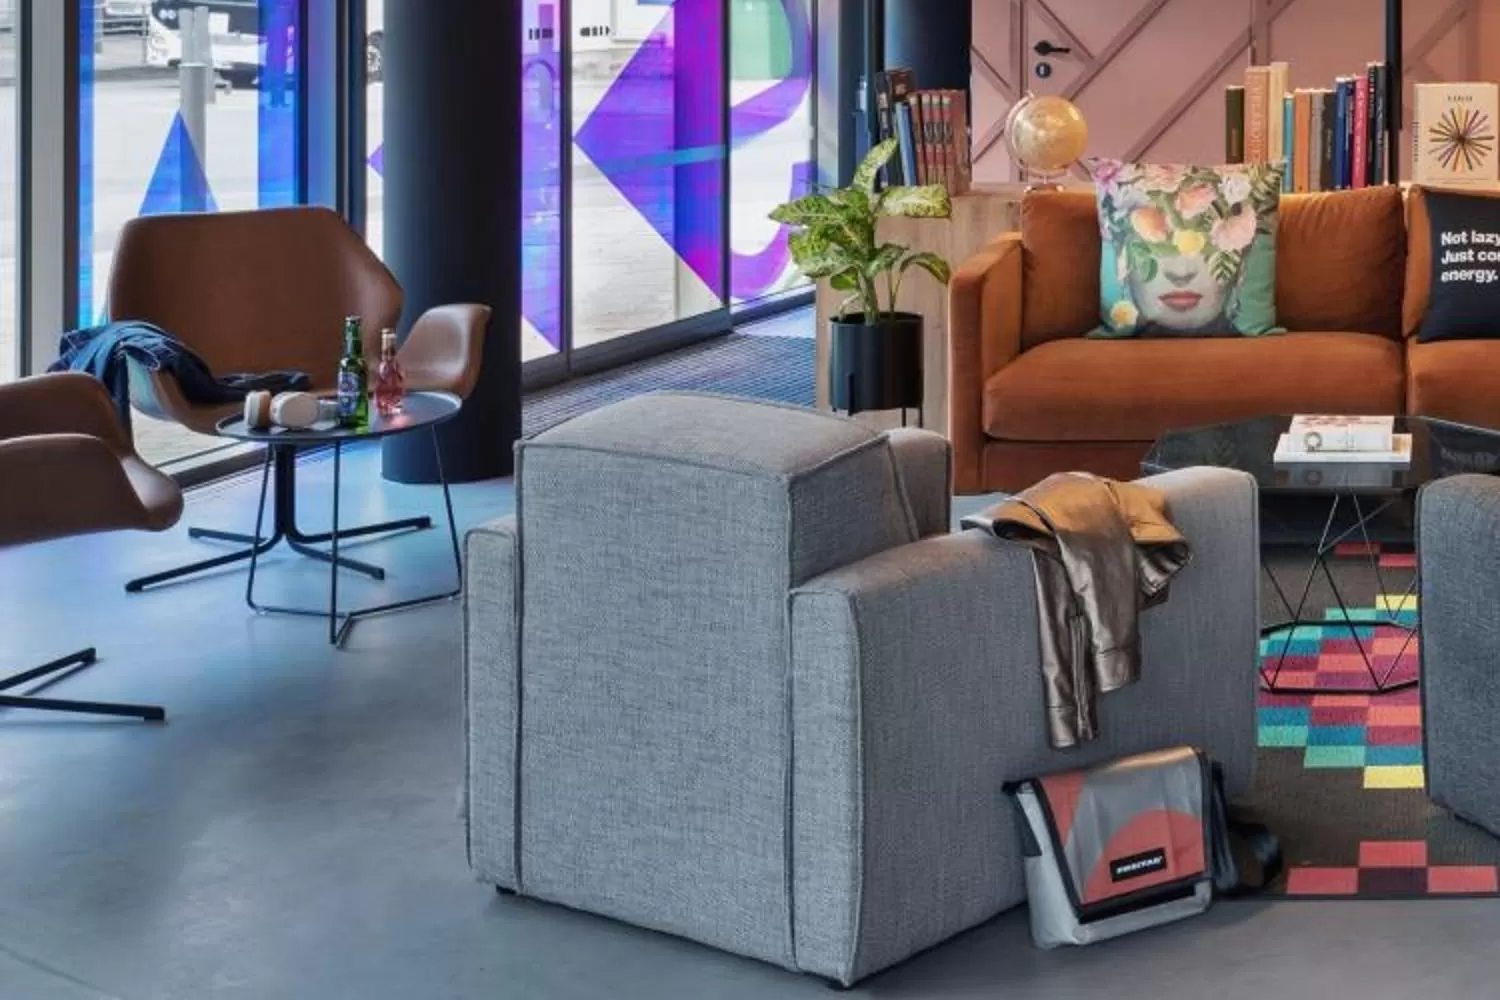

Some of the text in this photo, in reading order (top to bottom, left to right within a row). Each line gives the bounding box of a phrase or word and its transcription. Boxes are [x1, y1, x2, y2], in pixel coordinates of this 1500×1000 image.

[1441, 231, 1468, 246] Not
[1441, 249, 1475, 265] Just
[1441, 269, 1499, 283] energy.
